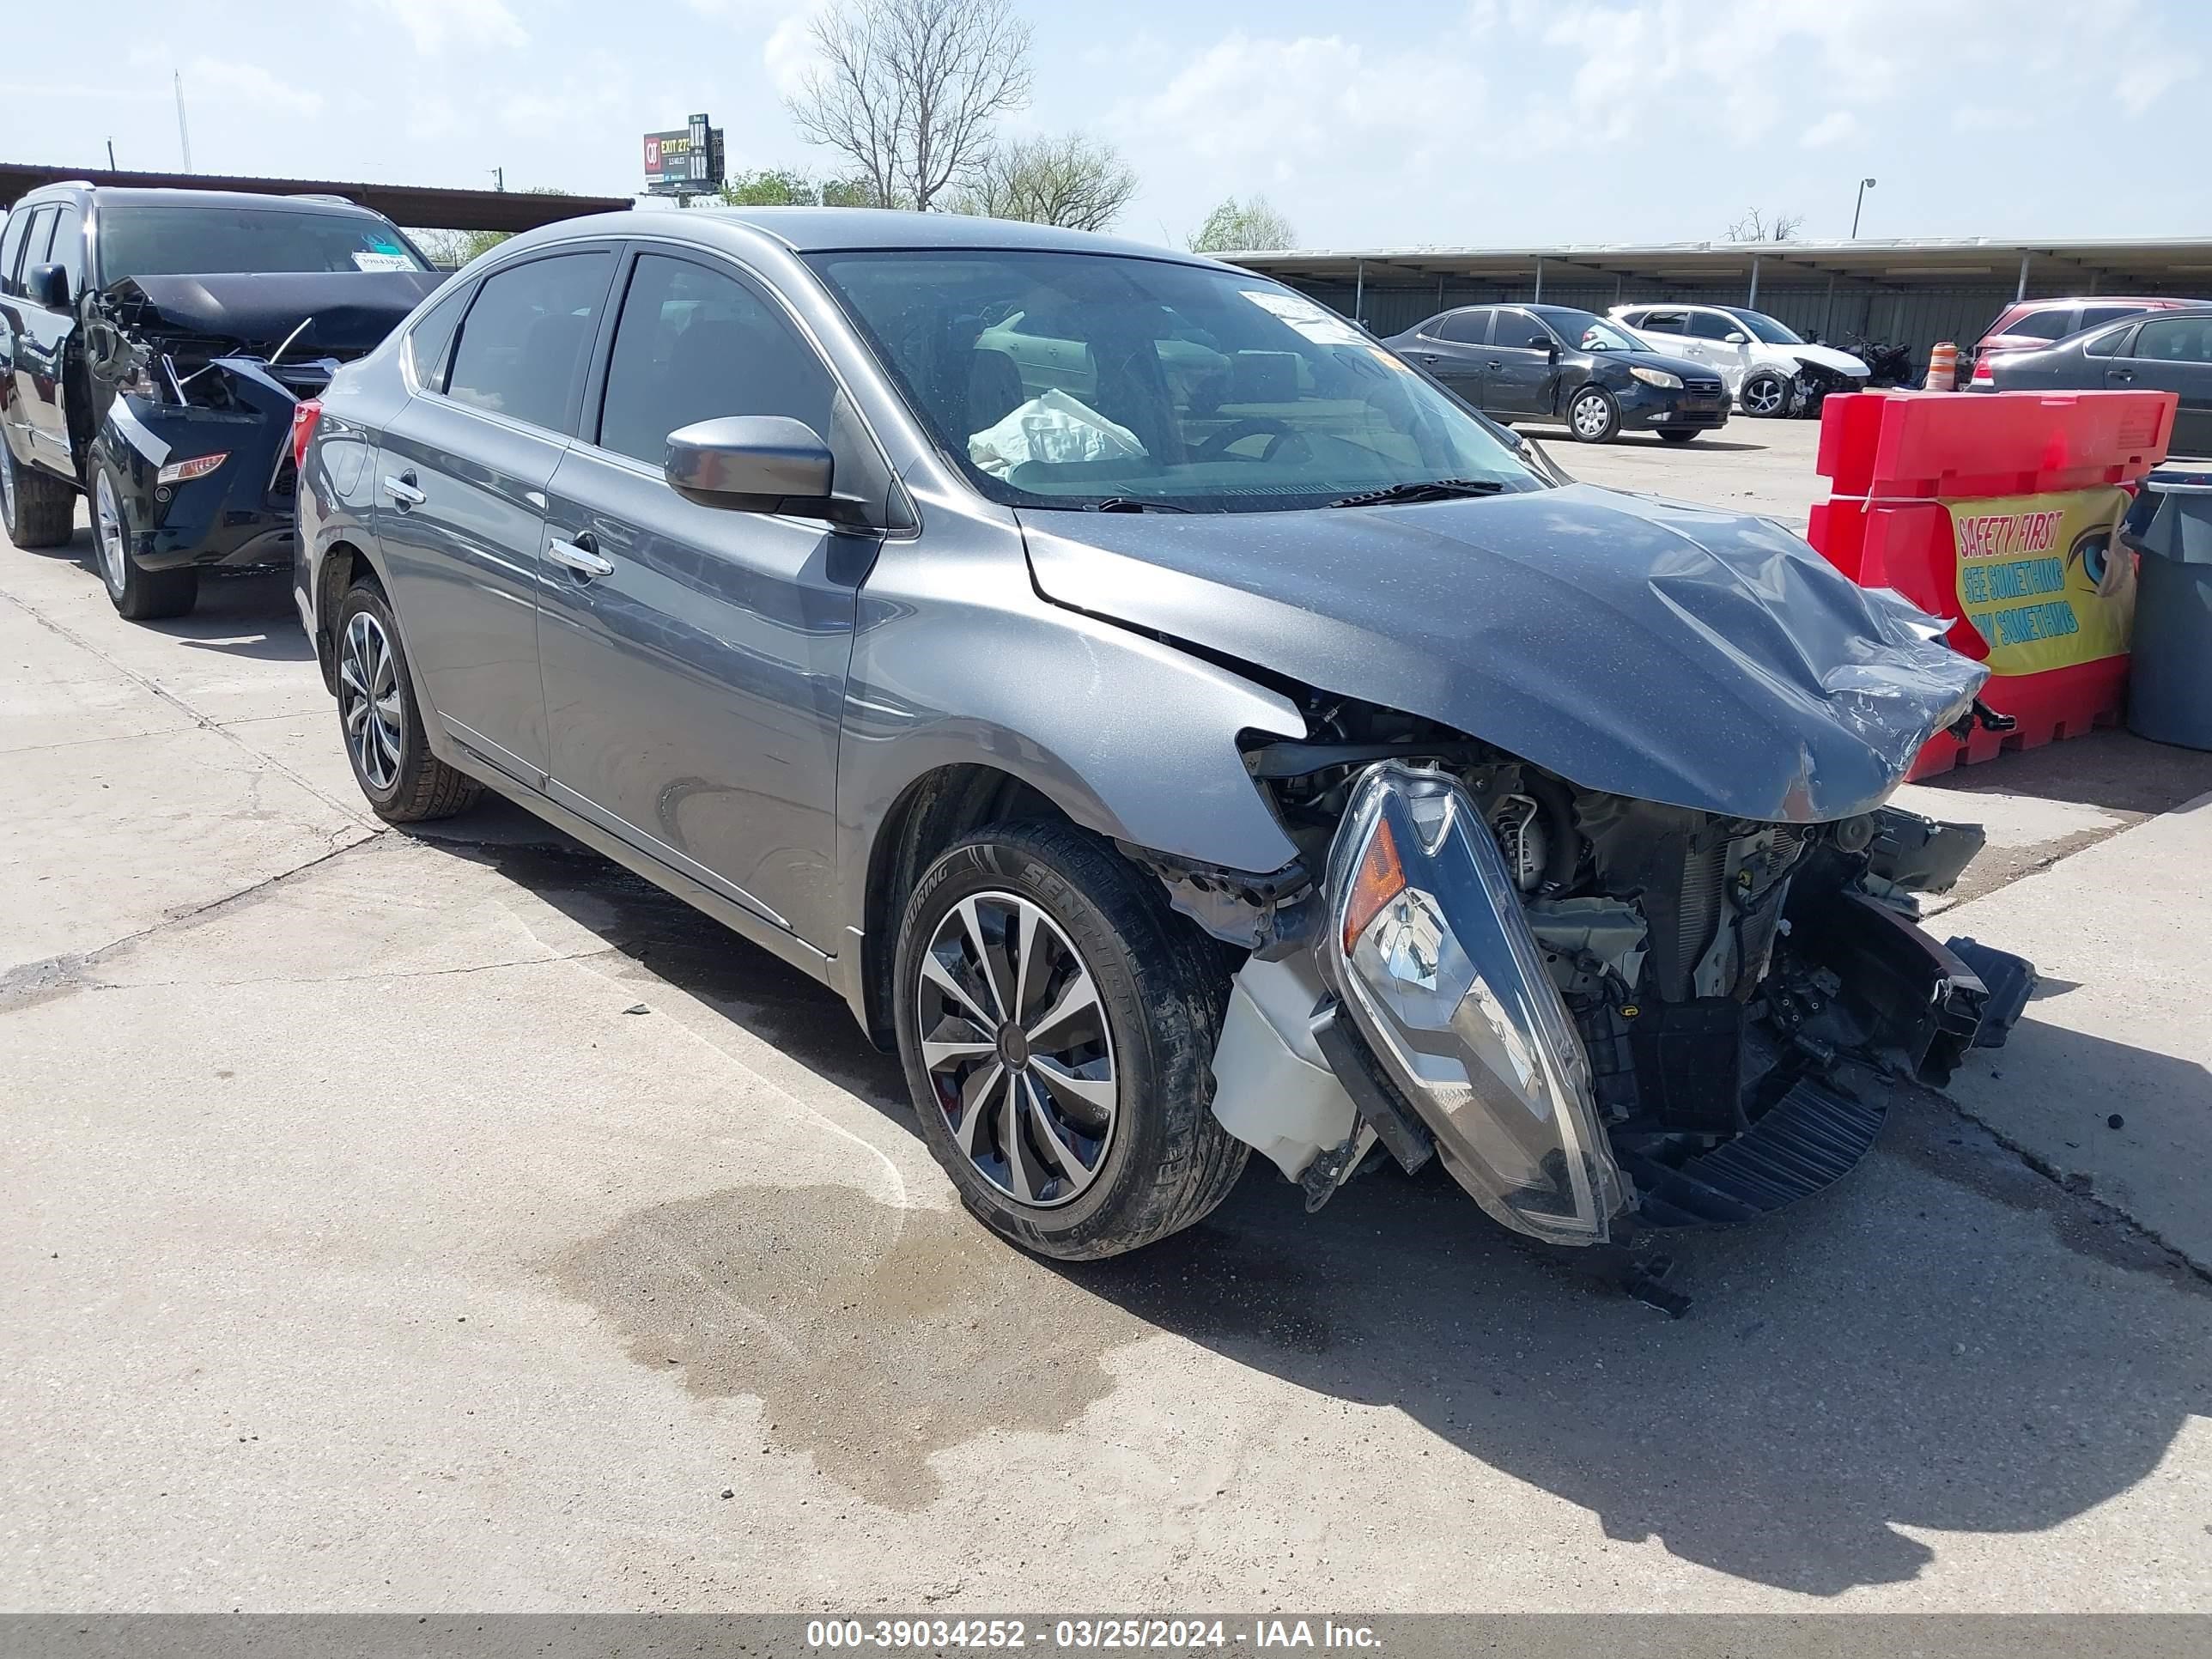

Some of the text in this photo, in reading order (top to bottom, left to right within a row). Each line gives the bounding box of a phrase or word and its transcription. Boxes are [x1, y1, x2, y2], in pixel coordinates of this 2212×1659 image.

[647, 143, 658, 165] QT
[661, 139, 677, 154] EXIT
[1959, 510, 2064, 559] SAFETY FIRST
[1962, 557, 2064, 604] SEE SOMETHING
[1996, 601, 2079, 645] SOMETHING
[900, 861, 949, 951] TOURING
